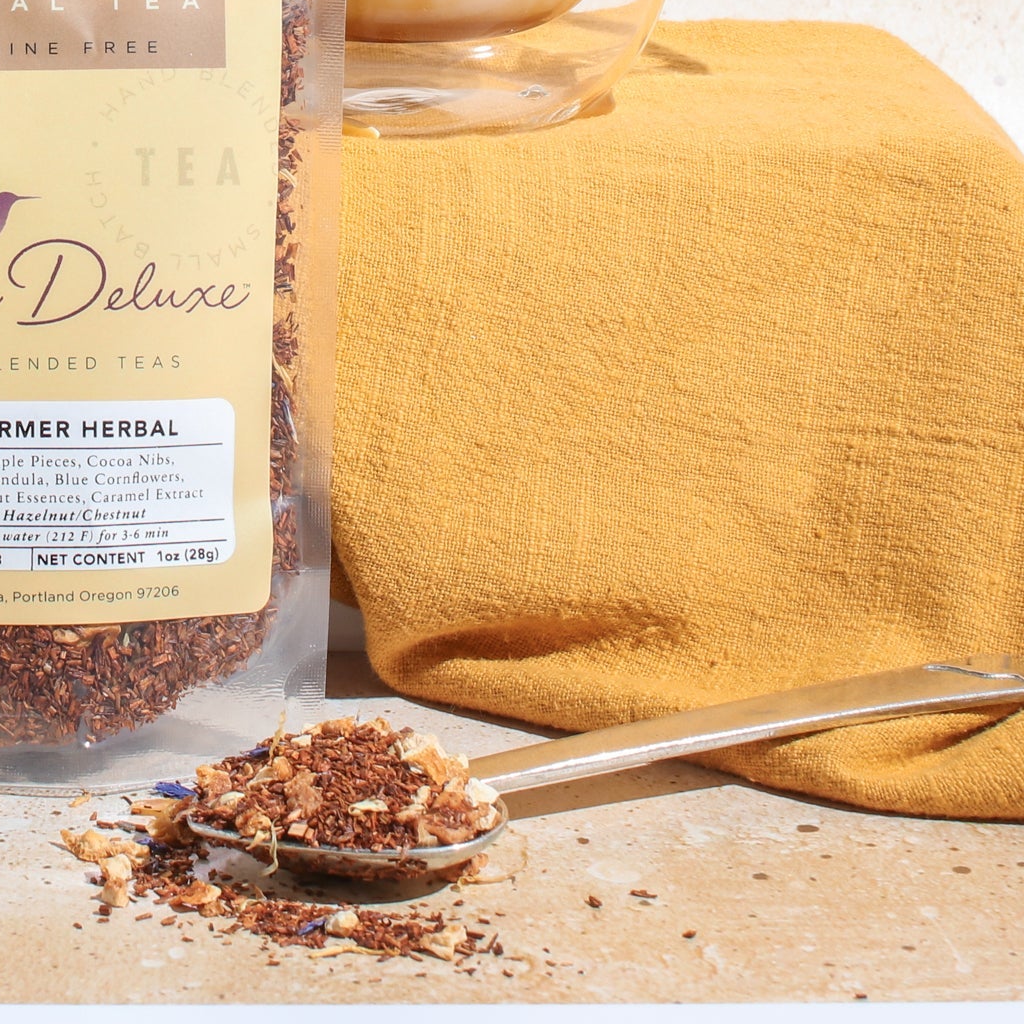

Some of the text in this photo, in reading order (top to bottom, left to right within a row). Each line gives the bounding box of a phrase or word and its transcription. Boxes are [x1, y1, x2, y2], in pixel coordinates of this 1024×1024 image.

[84, 41, 157, 54] FREE
[134, 147, 241, 187] TEA
[84, 169, 261, 271] SMALL BATCH
[118, 355, 179, 369] TEAS
[81, 419, 179, 438] HERBAL
[31, 455, 82, 468] Pieces,
[86, 455, 133, 467] Cocoa
[138, 453, 175, 466] Nibs,
[55, 473, 89, 485] Blue
[94, 471, 185, 485] Cornflowers,
[17, 492, 86, 505] Essences,
[90, 489, 150, 503] Caramel
[156, 489, 204, 500] Extract
[2, 509, 146, 522] Hazelnut/Chestnut
[2, 532, 41, 541] water
[46, 531, 75, 543] (212
[79, 531, 94, 542] F)
[95, 529, 118, 544] for
[121, 529, 140, 540] 3-6
[144, 527, 169, 538] min
[37, 547, 220, 566] NET CONTENT 1oz (28g)
[12, 591, 75, 602] Portland
[79, 591, 133, 602] Oregon
[136, 586, 180, 599] 97206
